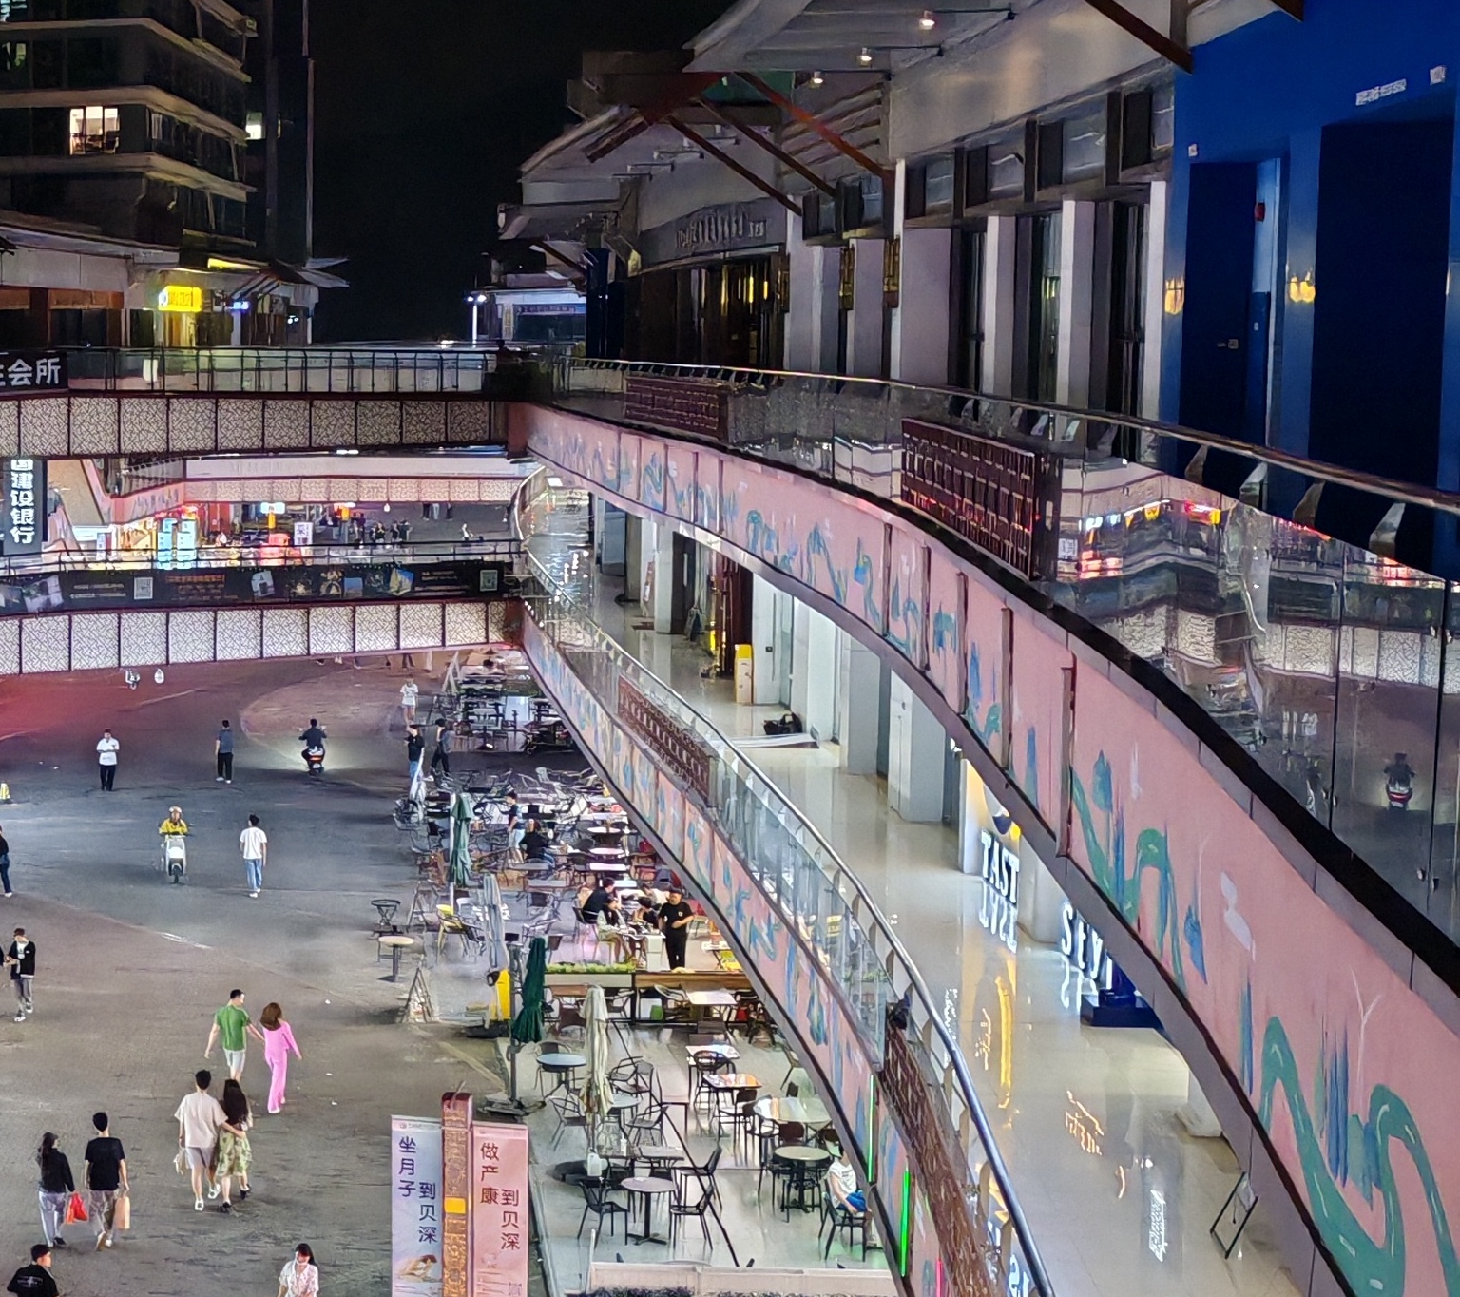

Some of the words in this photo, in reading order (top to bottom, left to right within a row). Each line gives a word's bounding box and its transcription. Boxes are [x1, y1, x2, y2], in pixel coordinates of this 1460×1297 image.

[398, 1135, 417, 1198] 坐月子
[480, 1142, 500, 1205] 做产康
[417, 1182, 438, 1245] 到贝深
[500, 1188, 520, 1251] 到贝深
